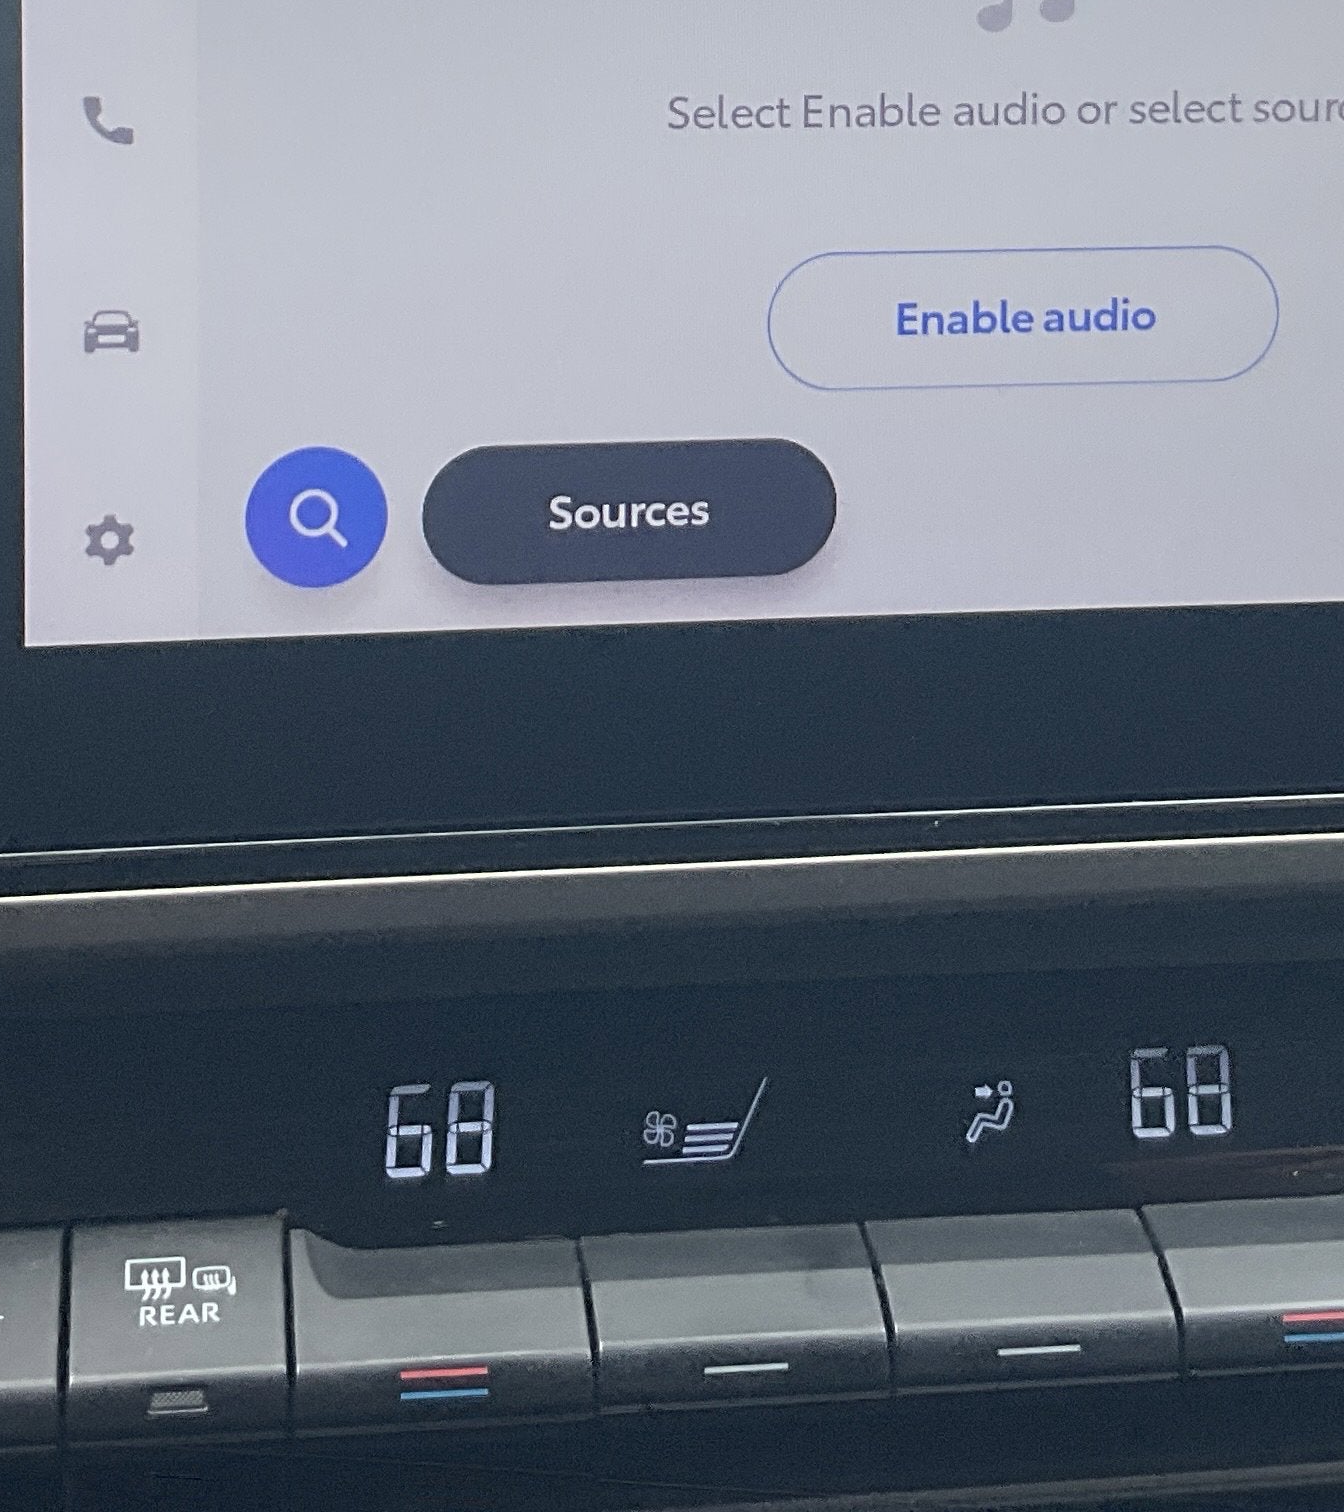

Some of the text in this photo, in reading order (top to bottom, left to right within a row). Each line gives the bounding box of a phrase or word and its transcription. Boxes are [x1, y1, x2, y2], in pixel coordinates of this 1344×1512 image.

[667, 93, 791, 130] Select
[803, 92, 941, 128] Enable
[953, 91, 1065, 127] audio
[1077, 97, 1118, 126] or
[1128, 91, 1244, 126] select
[897, 296, 1156, 337] Enable audio
[547, 493, 710, 532] Sources
[1130, 1043, 1233, 1140] 68
[384, 1079, 494, 1180] 68
[138, 1301, 220, 1327] REAR
